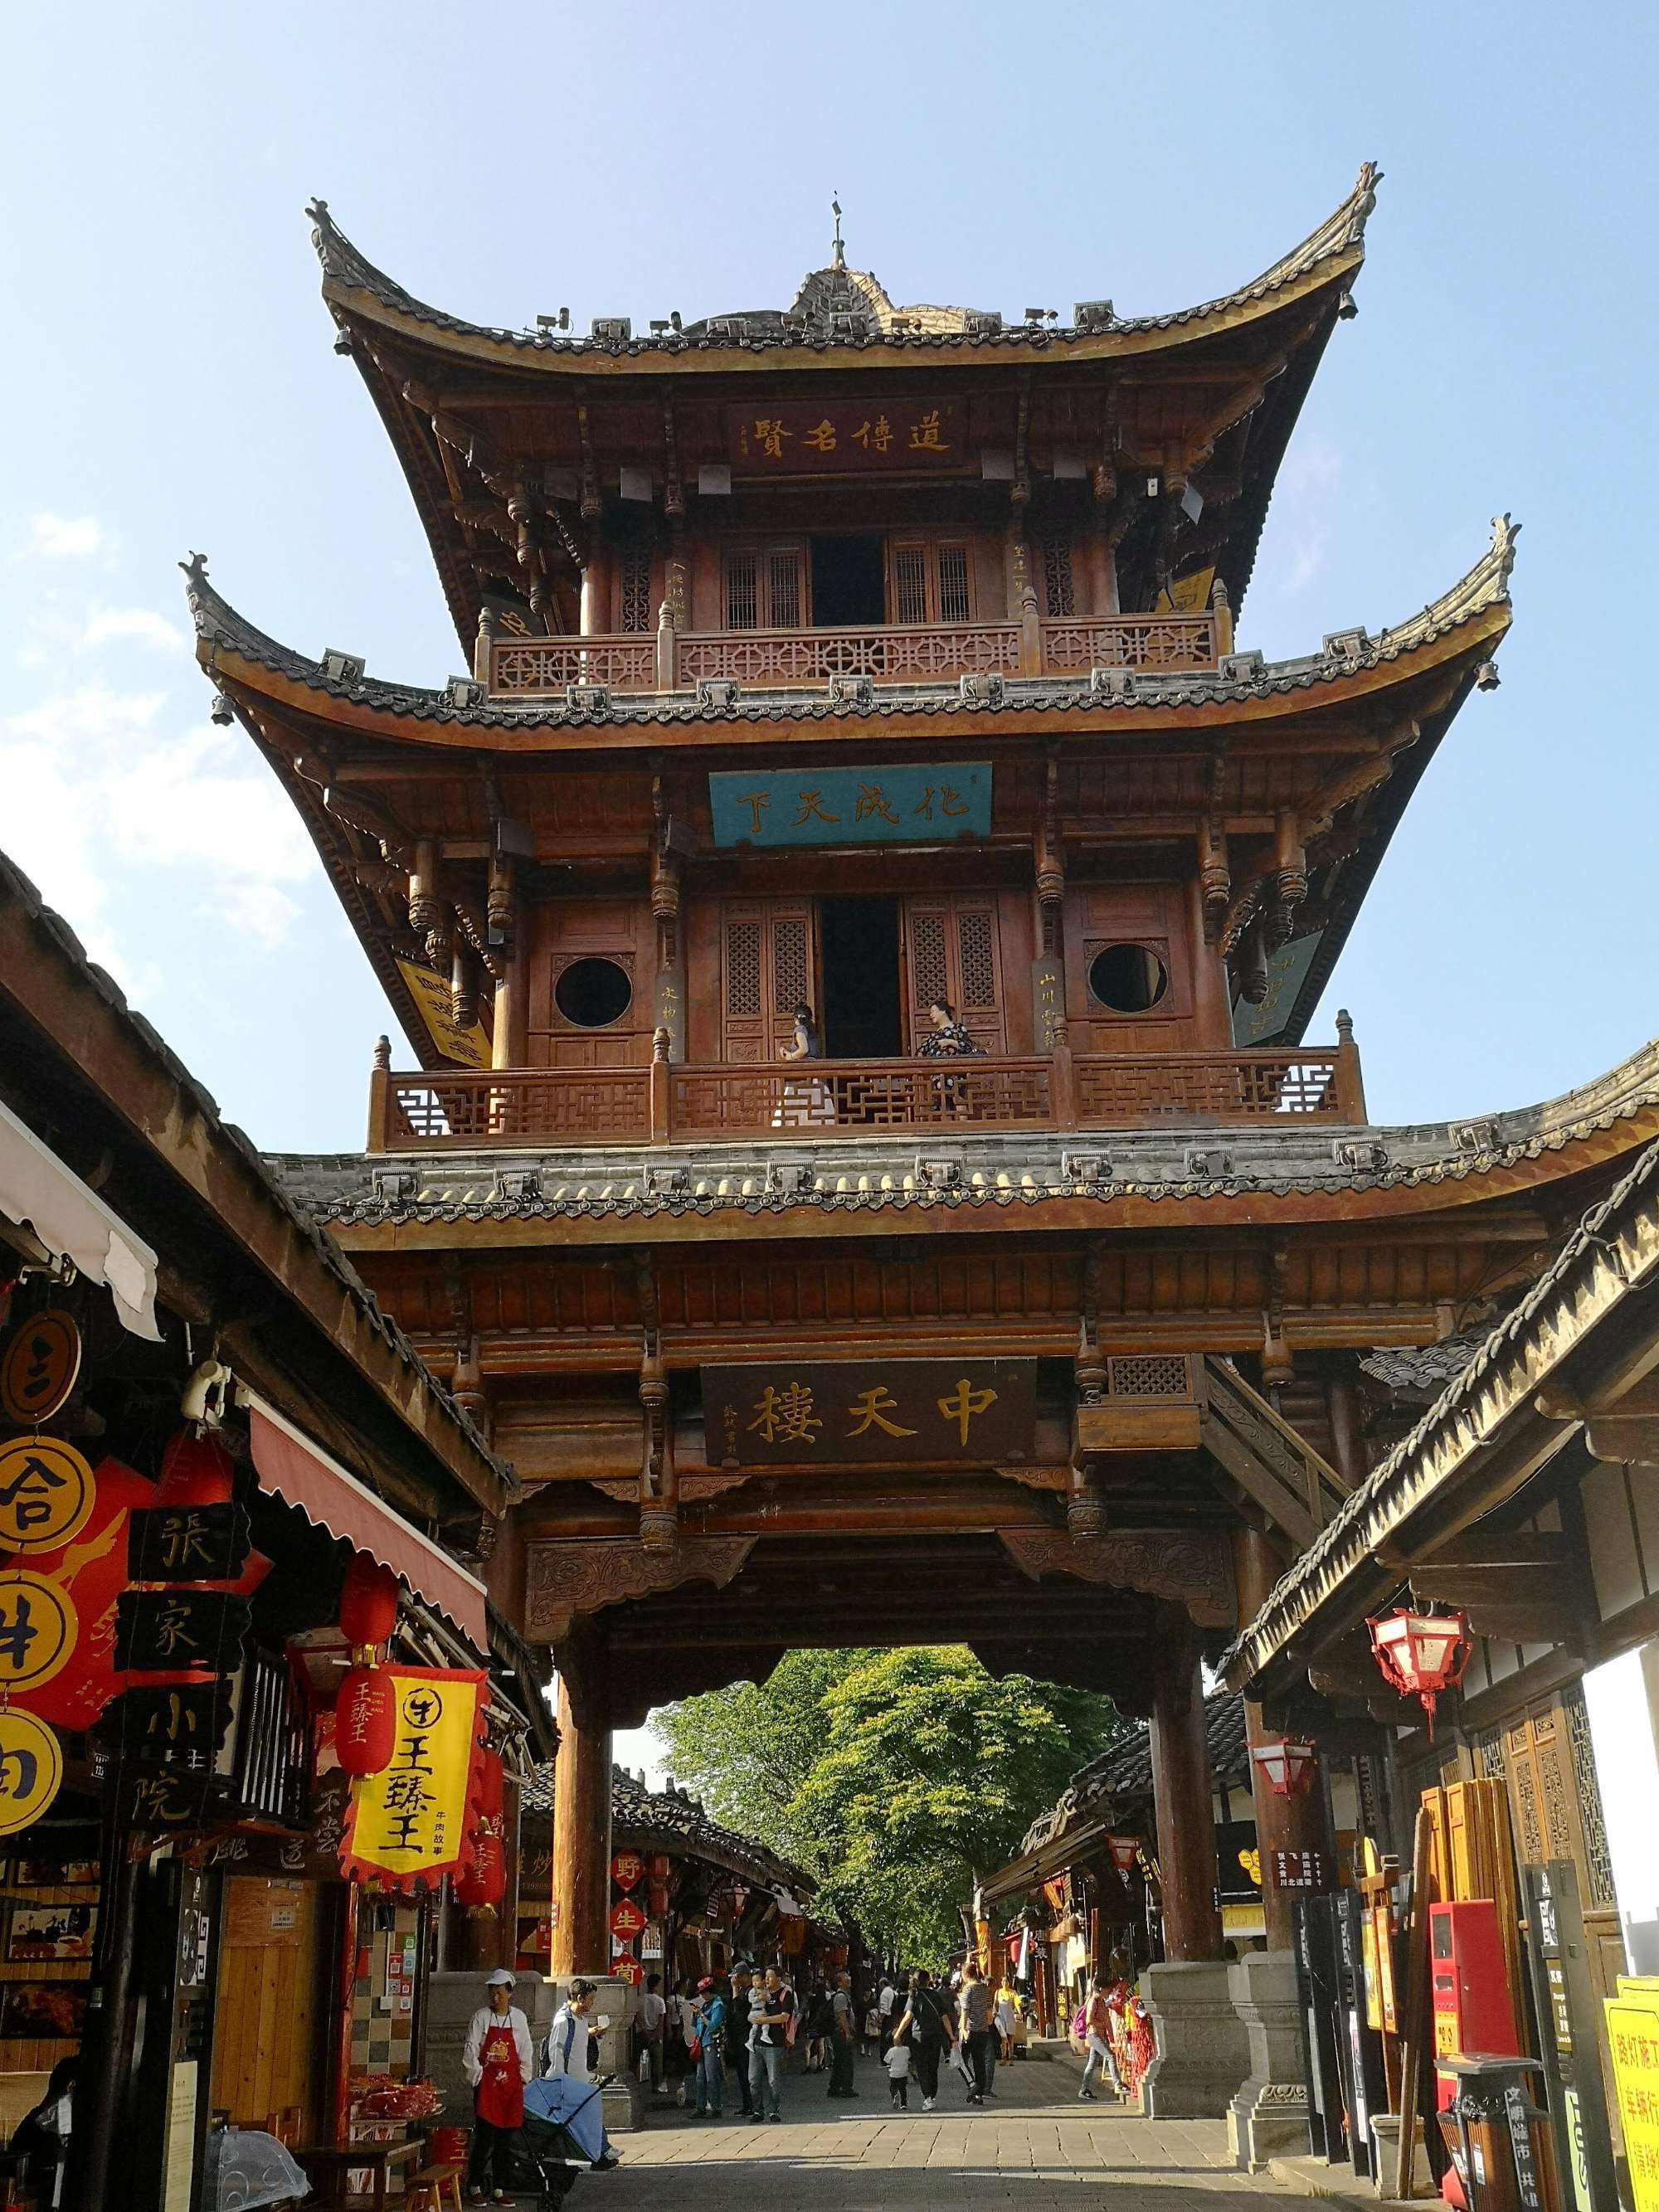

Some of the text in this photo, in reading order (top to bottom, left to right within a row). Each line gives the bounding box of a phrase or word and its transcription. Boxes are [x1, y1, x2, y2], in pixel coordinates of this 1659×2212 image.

[747, 1378, 999, 1447] 中天樓
[378, 1735, 437, 1854] 王臻王
[1506, 2087, 1530, 2160] 文明城市
